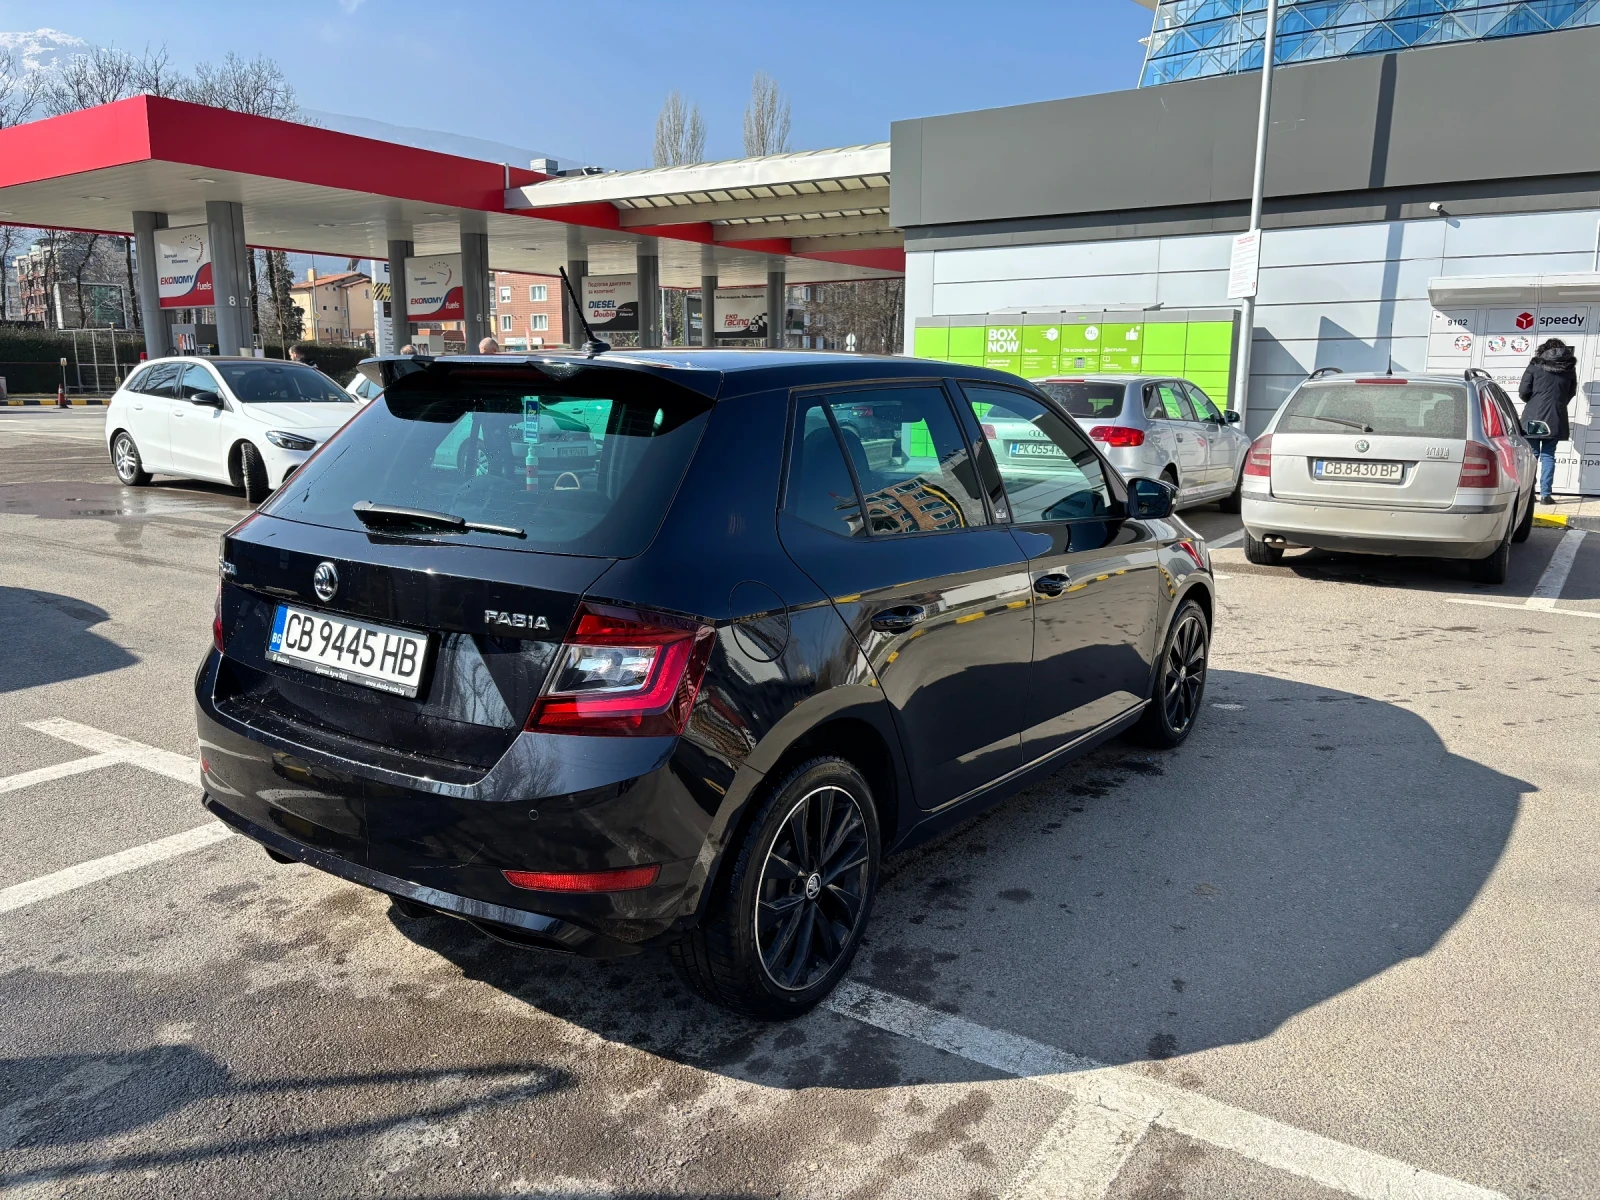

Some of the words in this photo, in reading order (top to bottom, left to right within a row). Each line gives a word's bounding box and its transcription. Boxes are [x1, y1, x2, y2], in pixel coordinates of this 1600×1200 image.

[160, 275, 194, 285] EKONOMY
[197, 281, 212, 290] fuels
[229, 296, 236, 306] 8
[244, 297, 250, 307] 7
[411, 297, 443, 305] EKONOMY
[446, 301, 460, 309] fuels
[588, 300, 616, 309] DIESEL
[476, 314, 482, 322] 6
[593, 310, 616, 318] Double
[724, 319, 750, 328] racing
[1447, 318, 1468, 326] 9102
[1539, 314, 1585, 327] speedy
[988, 328, 1017, 341] BOX
[987, 341, 1019, 353] NOW
[1018, 443, 1029, 454] PK
[1032, 444, 1054, 454] 0554
[1580, 459, 1600, 467] пра
[1380, 465, 1399, 477] BP
[484, 609, 550, 630] FABIA
[272, 632, 282, 644] BG
[285, 613, 314, 652] CB
[318, 620, 378, 668] 9445
[379, 634, 418, 677] HB
